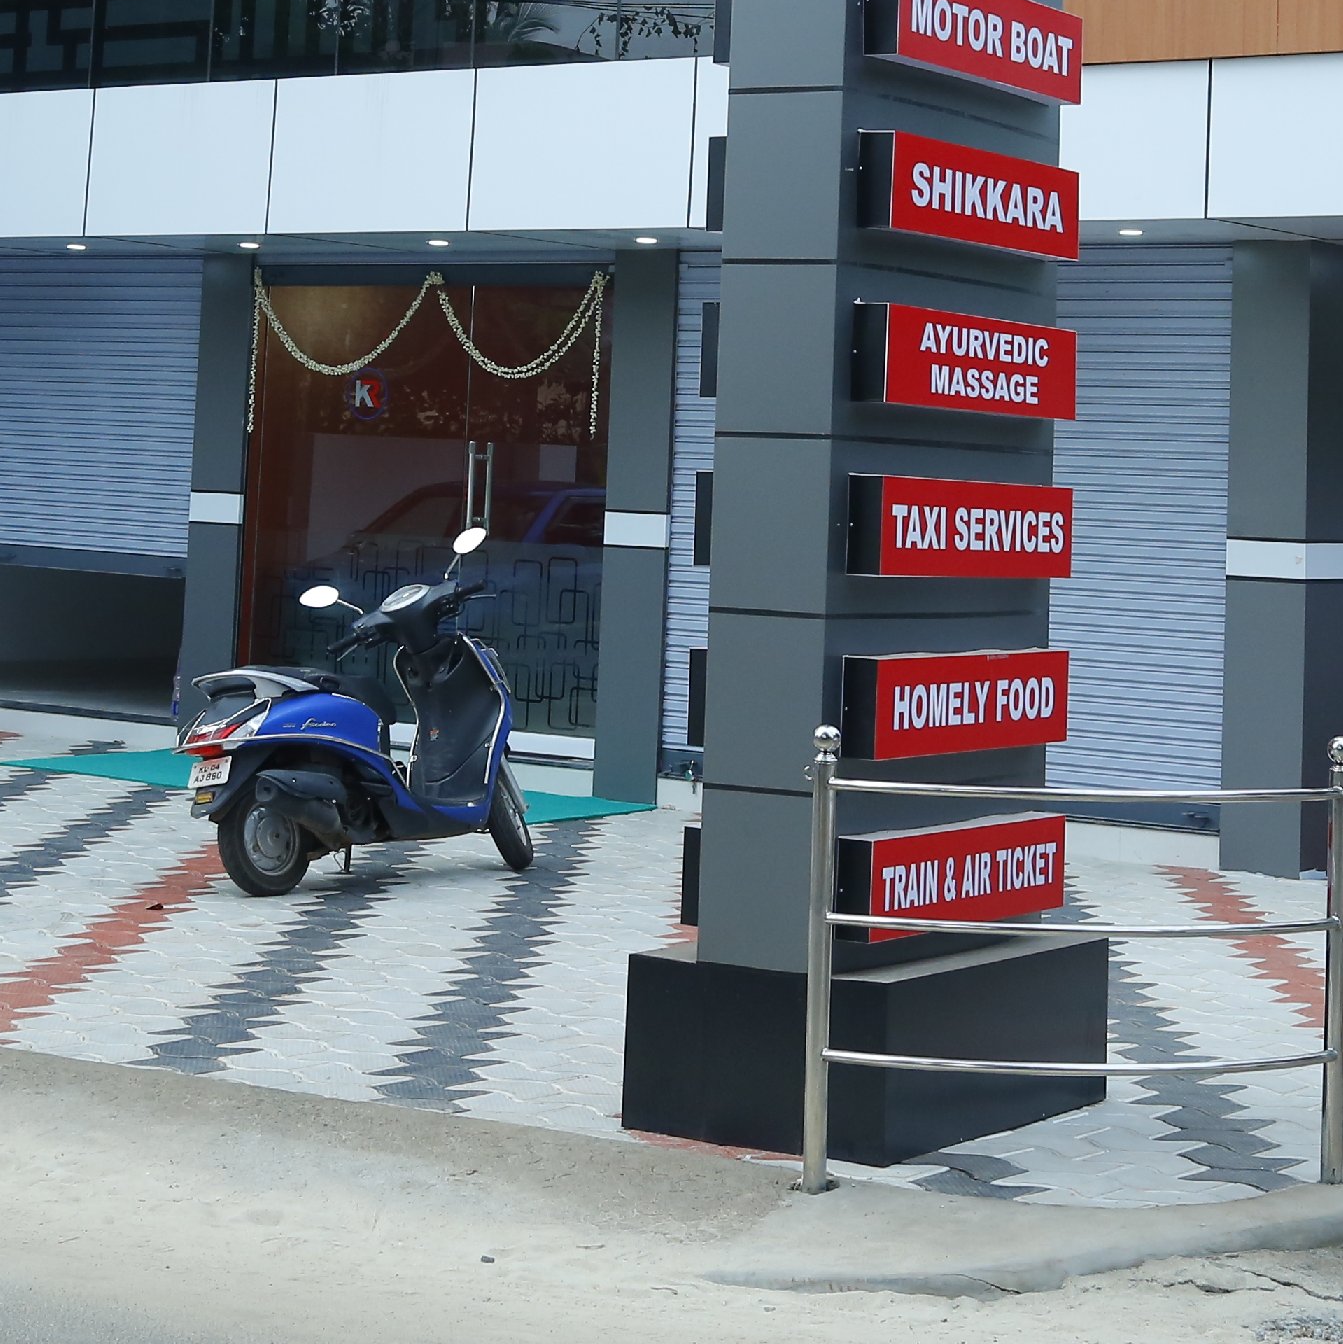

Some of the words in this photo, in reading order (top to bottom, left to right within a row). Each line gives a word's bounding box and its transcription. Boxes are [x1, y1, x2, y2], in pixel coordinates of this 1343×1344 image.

[1010, 20, 1073, 77] BOAT
[911, 161, 1064, 234] SHIKKARA
[919, 322, 1049, 368] AYURVEDIC
[930, 364, 1039, 405] MASSAGE
[891, 503, 947, 550] TAXI
[954, 507, 1064, 553] SERVICES
[892, 681, 991, 731] HOMELY
[996, 676, 1054, 722] FOOD
[882, 860, 939, 912] TRAIN
[943, 857, 956, 902] &
[961, 851, 991, 899] AIR
[996, 842, 1057, 892] TICKET
